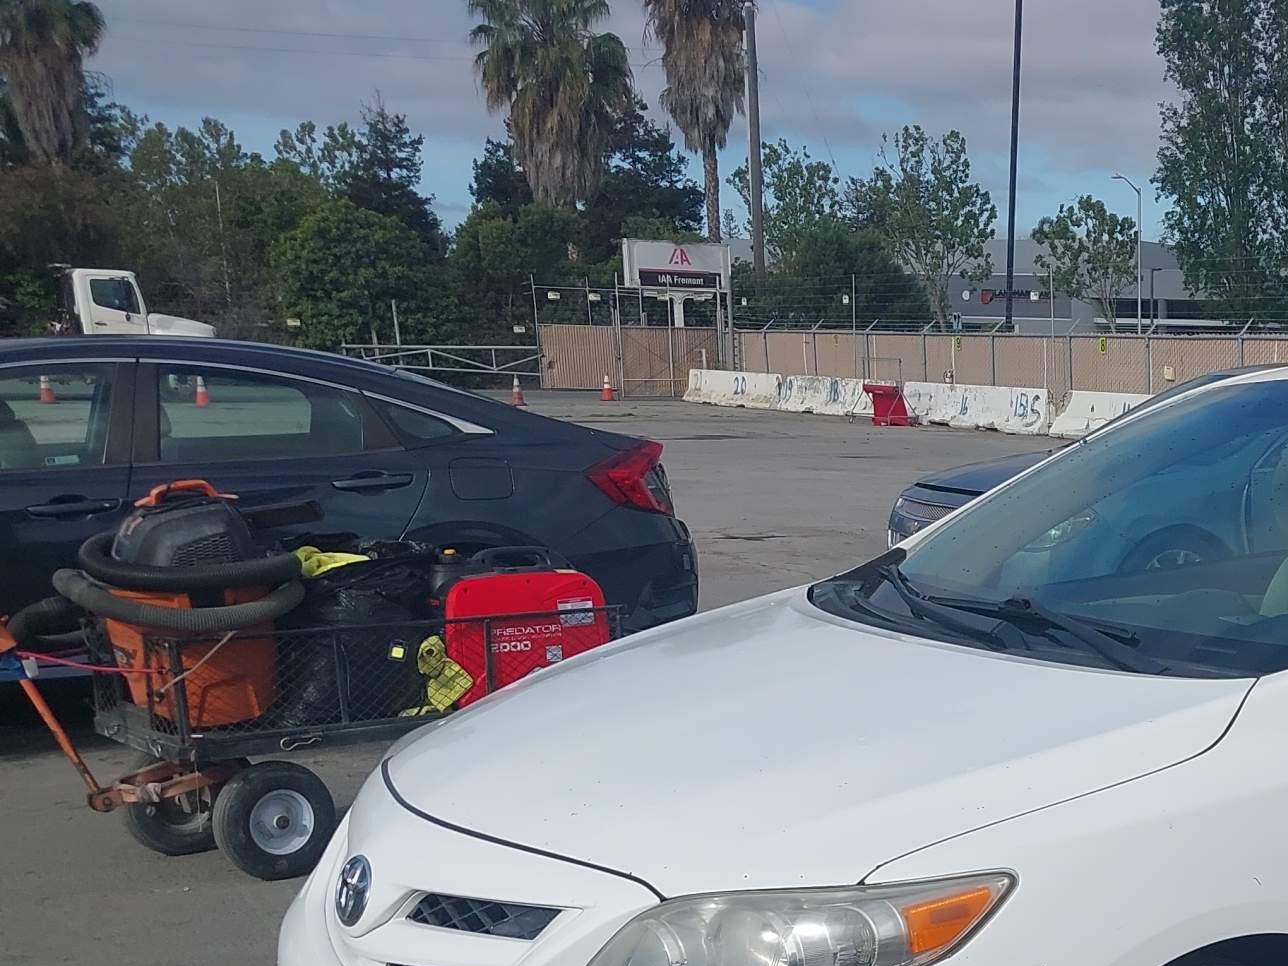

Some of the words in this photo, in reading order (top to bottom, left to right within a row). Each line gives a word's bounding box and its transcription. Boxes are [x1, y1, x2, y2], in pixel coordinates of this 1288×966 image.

[674, 276, 704, 286] Fremont
[733, 376, 748, 396] 20
[490, 641, 532, 653] 2000
